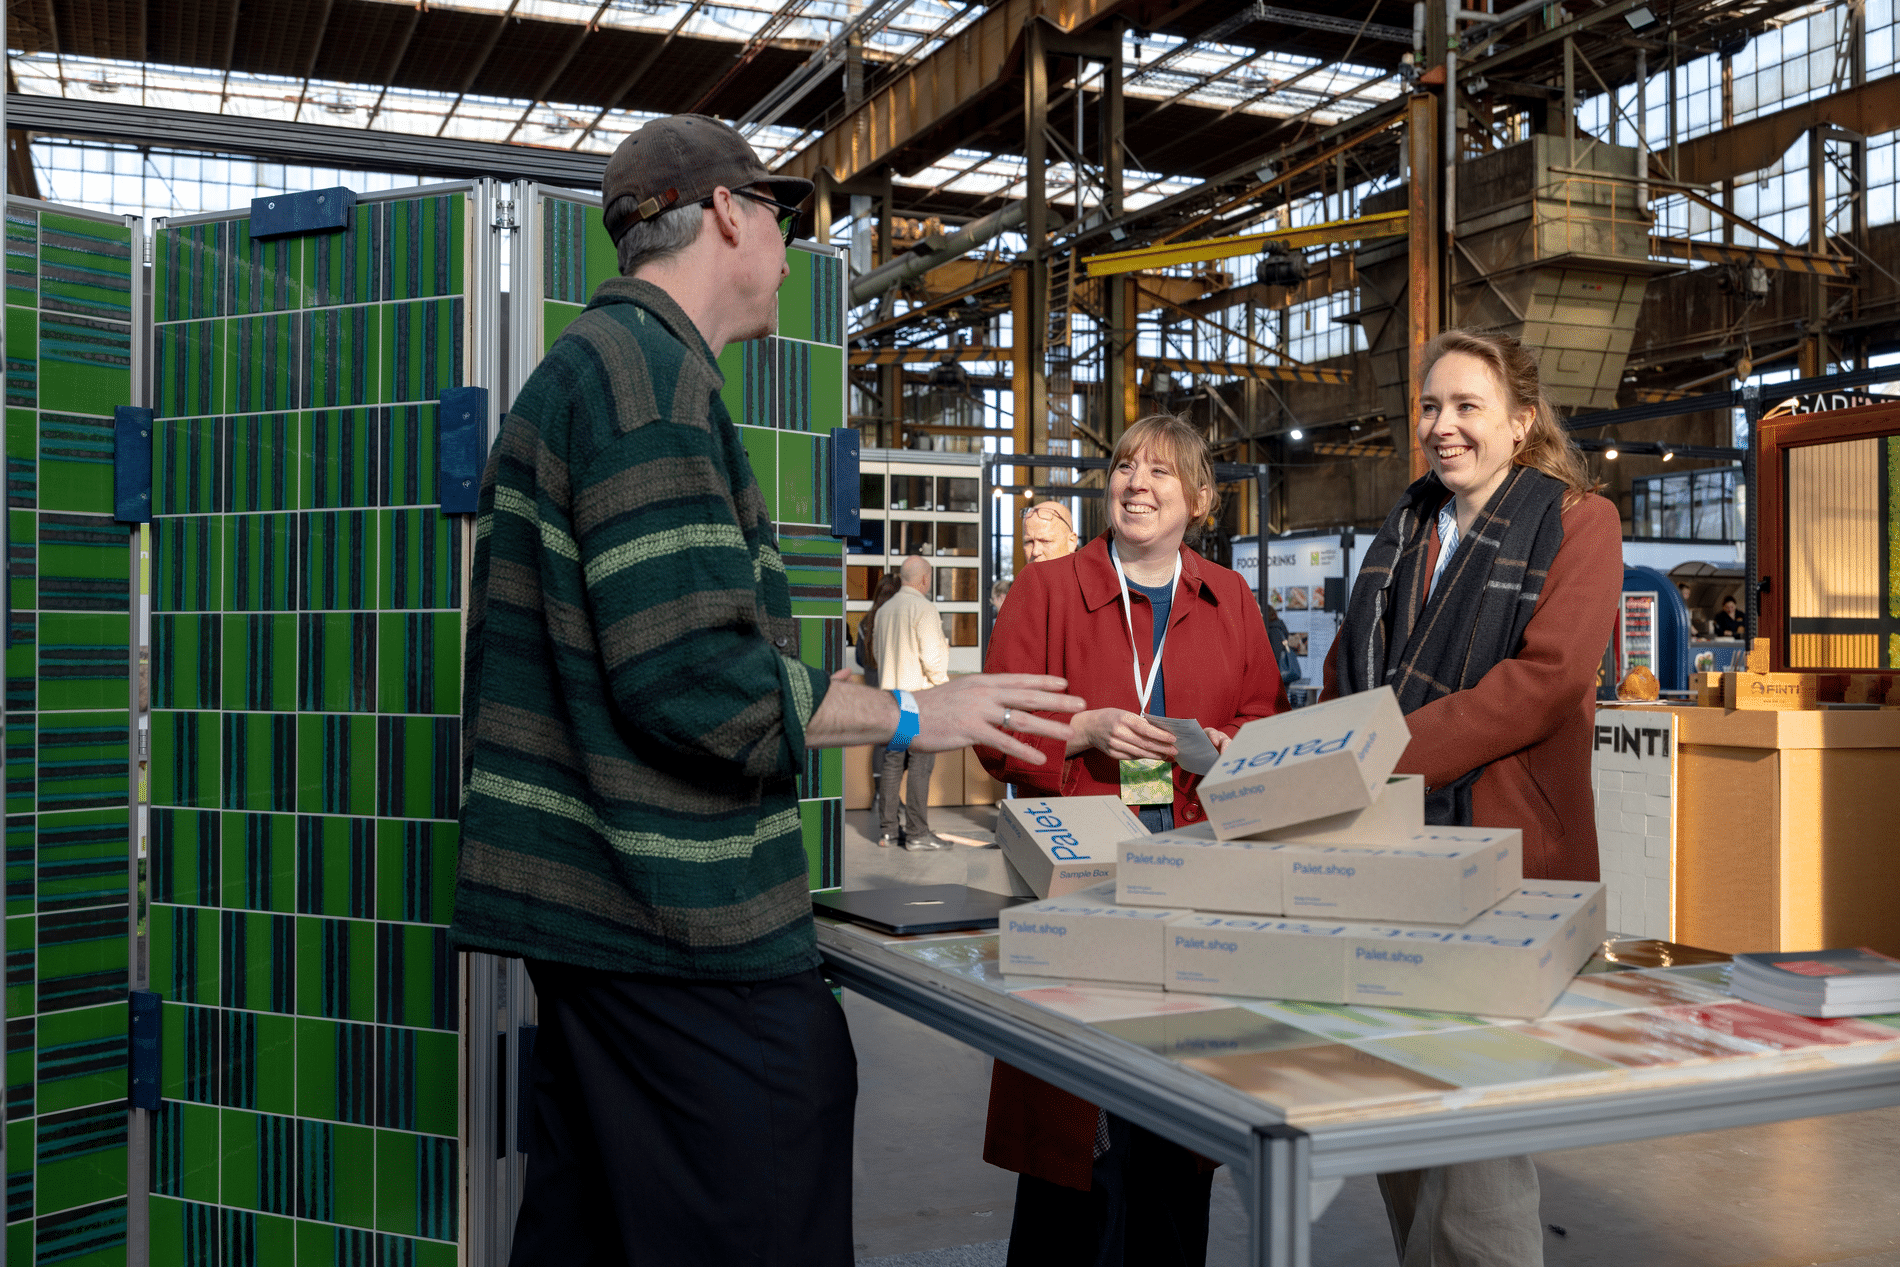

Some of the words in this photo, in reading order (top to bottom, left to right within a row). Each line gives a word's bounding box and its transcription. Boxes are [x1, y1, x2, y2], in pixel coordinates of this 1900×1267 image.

[1594, 723, 1669, 760] FINTI
[1222, 729, 1354, 776] Palet.
[1209, 784, 1265, 803] Palet.shop
[1023, 802, 1092, 861] Palet.
[1126, 852, 1185, 868] Palet.shop
[1059, 870, 1091, 880] Sample
[1093, 869, 1109, 878] Box
[1293, 862, 1356, 879] Palet.shop
[1009, 920, 1068, 937] Palet.shop
[1175, 935, 1238, 954] Palet.shop
[1356, 946, 1424, 965] Palet.shop
